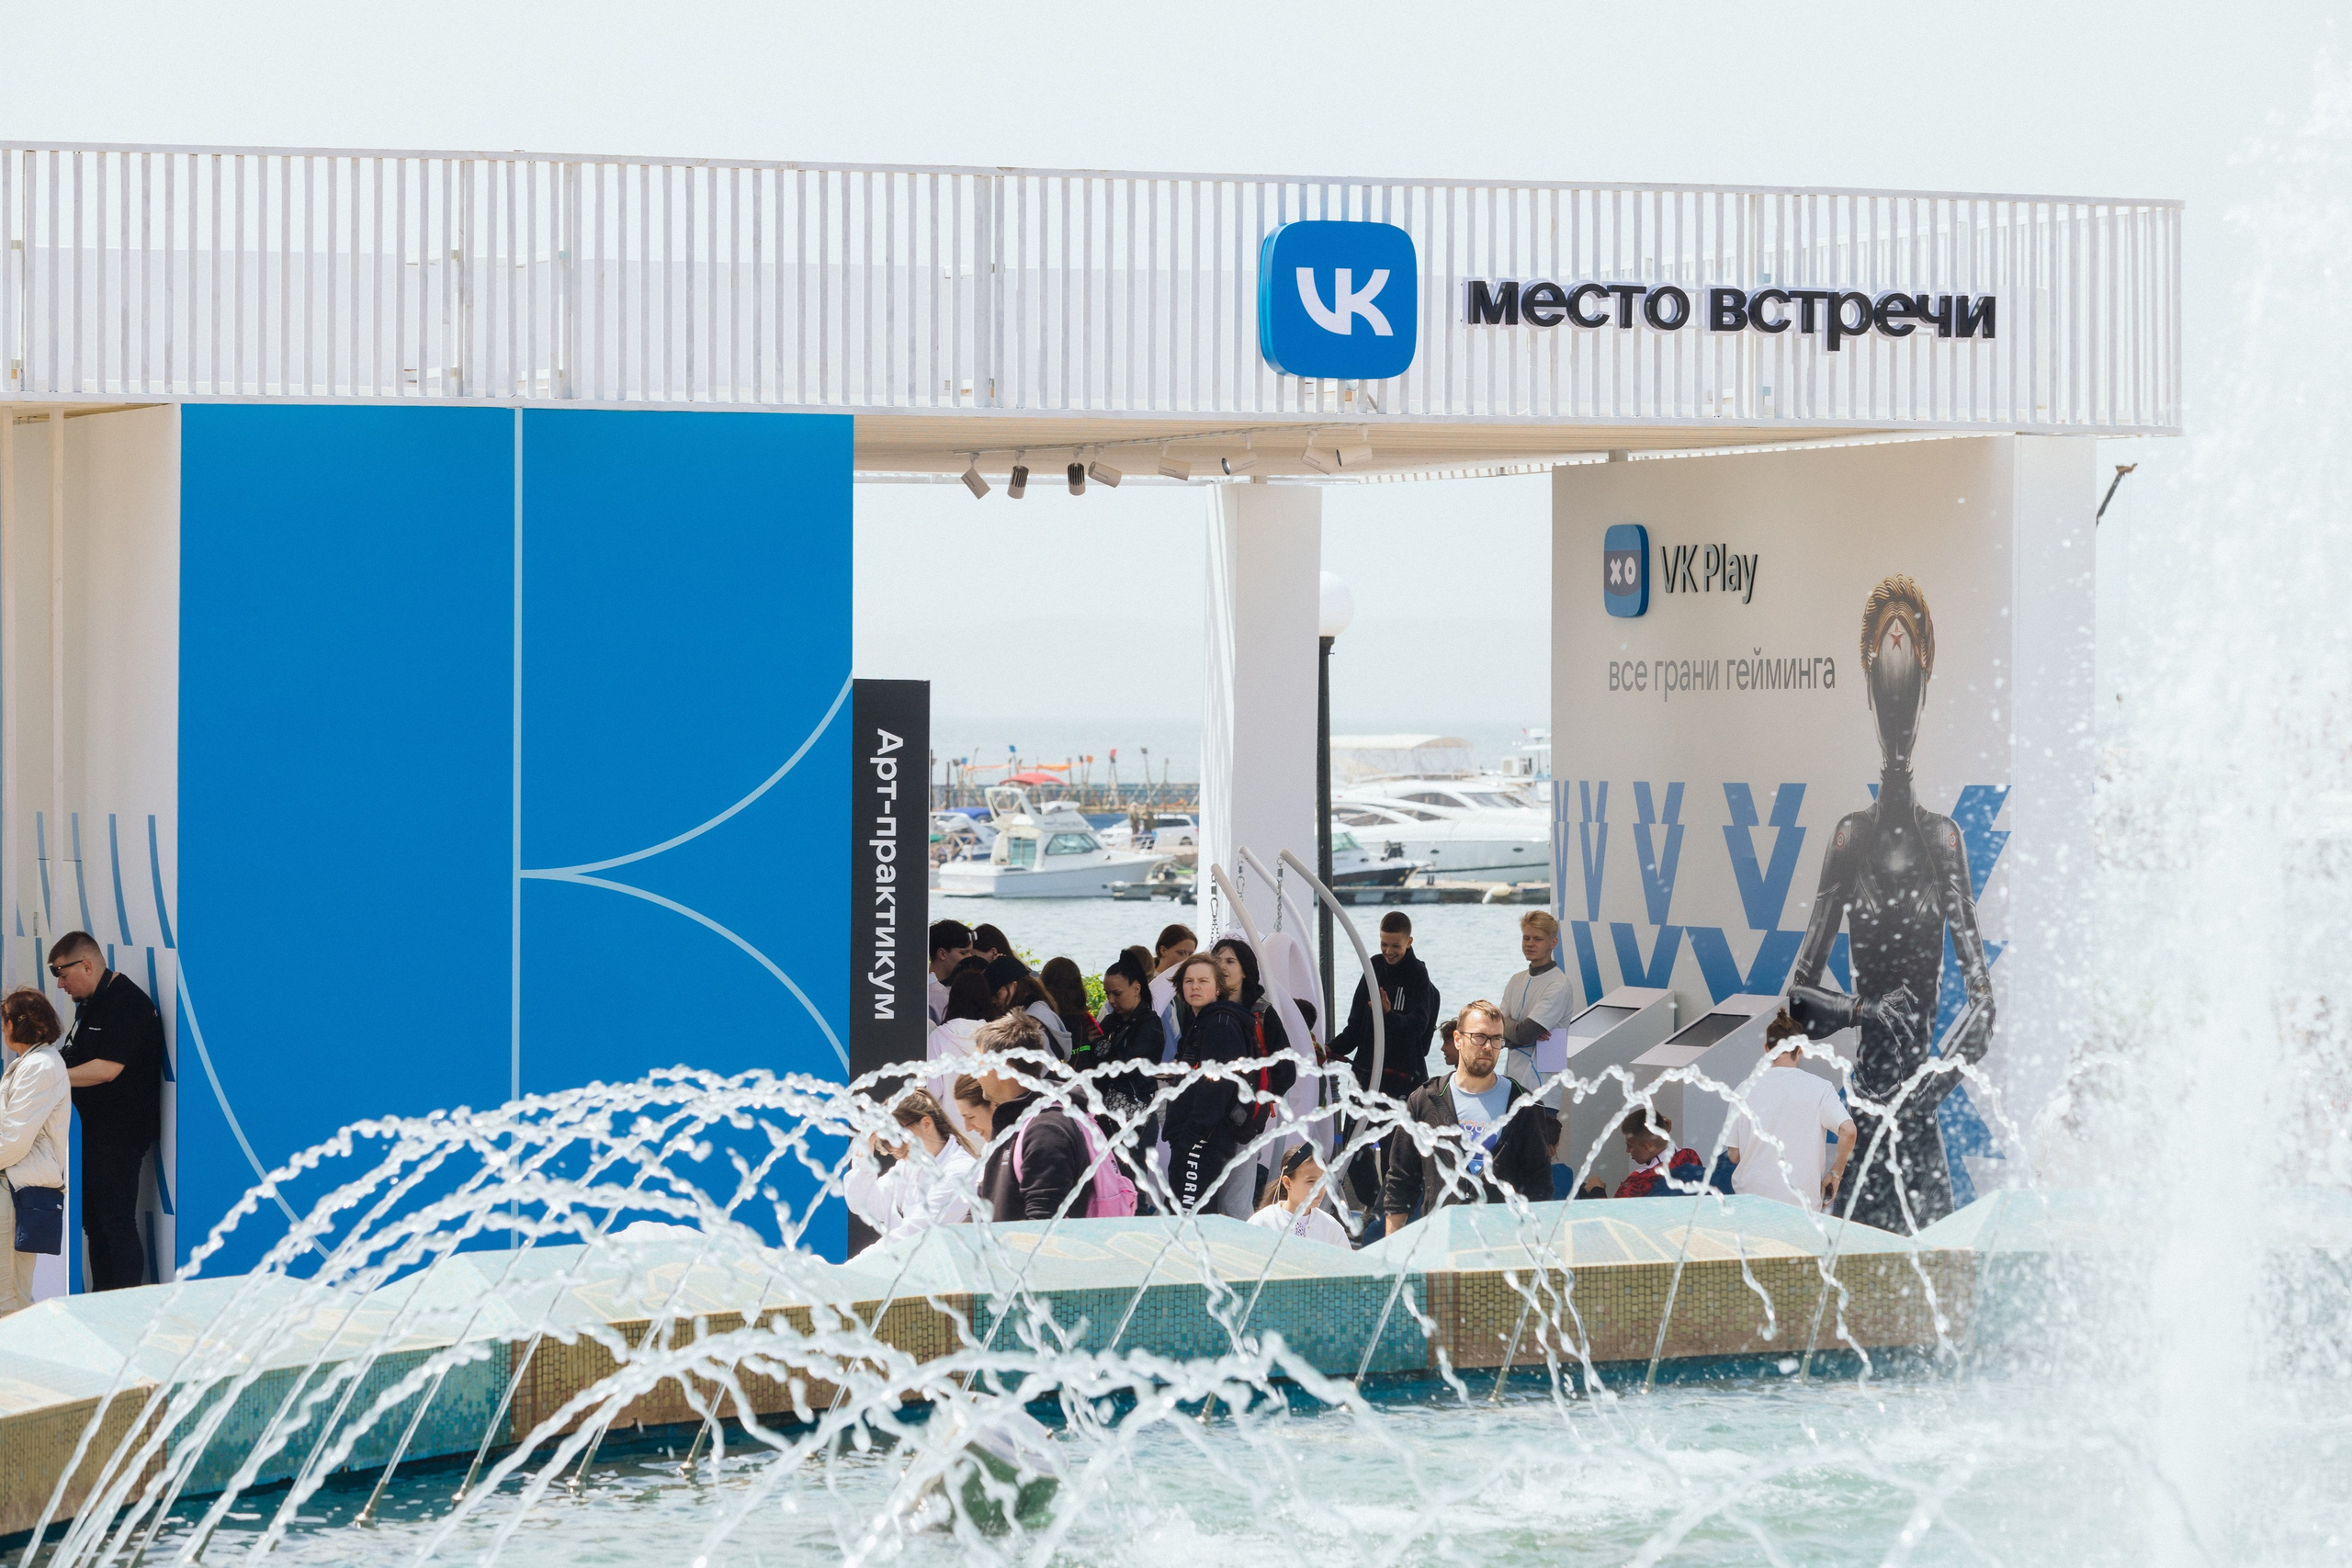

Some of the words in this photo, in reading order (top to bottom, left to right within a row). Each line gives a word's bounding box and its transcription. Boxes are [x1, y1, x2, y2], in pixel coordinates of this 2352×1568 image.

[1295, 266, 1394, 337] VK
[1709, 285, 1997, 353] встречи
[1659, 544, 1699, 593] VK
[1703, 543, 1758, 604] Play
[1609, 659, 1647, 693] все
[1654, 657, 1720, 703] грани
[1726, 647, 1836, 692] гейминга
[867, 728, 904, 1021] Арт-практикум
